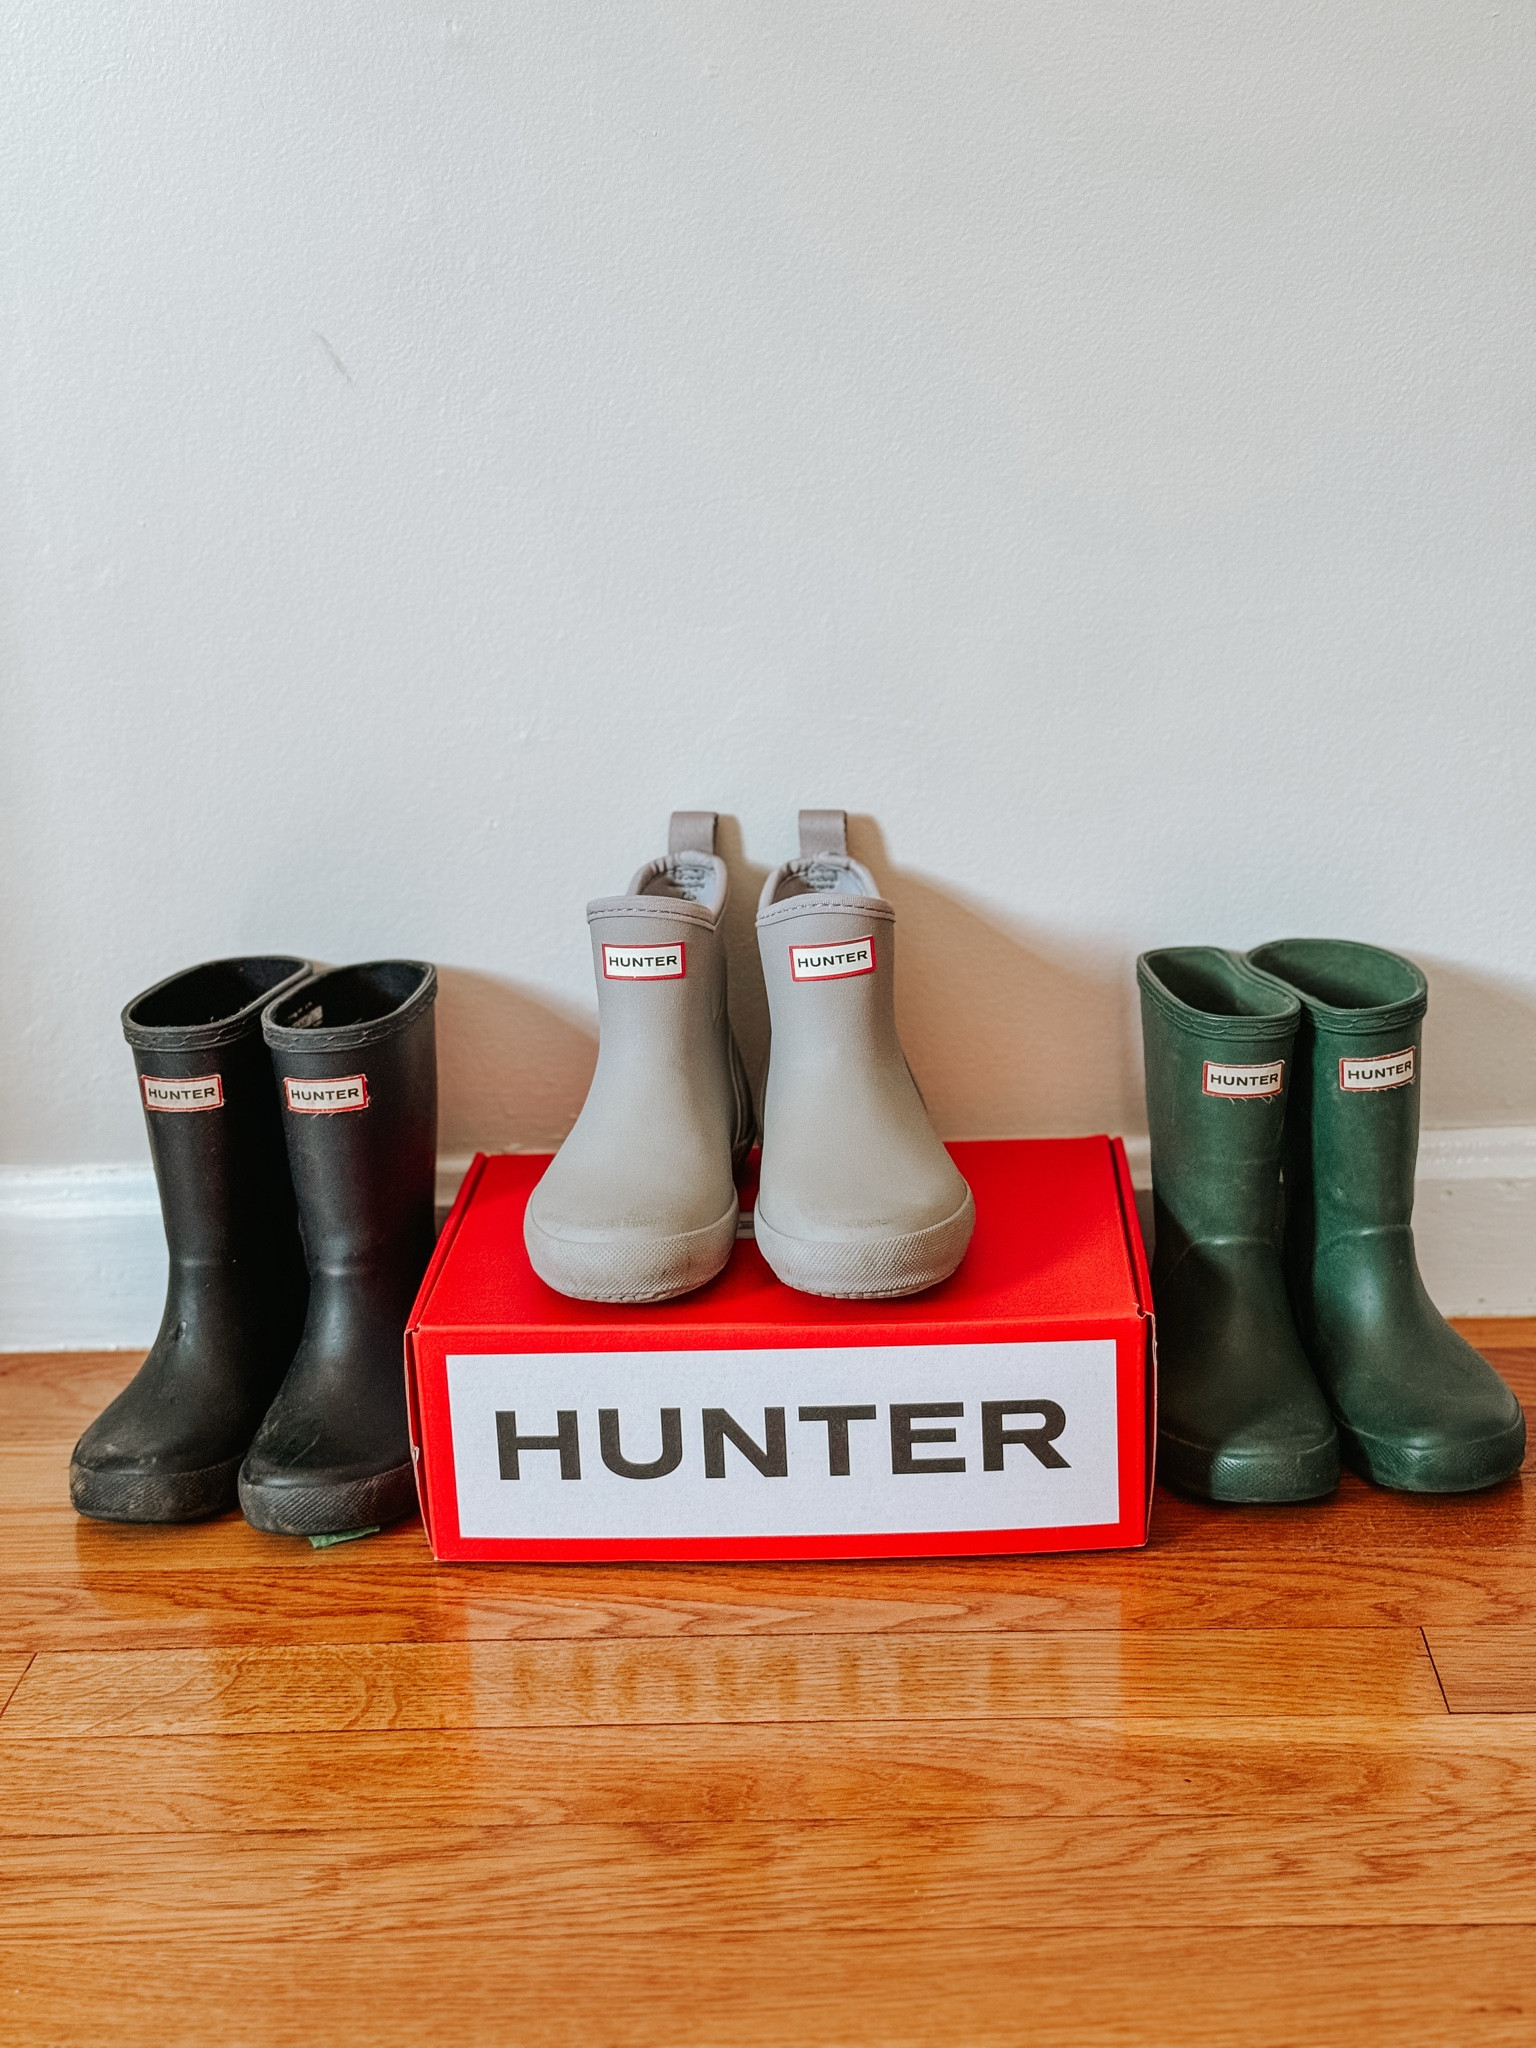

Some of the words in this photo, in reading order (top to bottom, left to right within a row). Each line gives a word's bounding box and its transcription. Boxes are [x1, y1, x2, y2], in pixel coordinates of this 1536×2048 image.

[609, 955, 677, 967] HUNTER
[797, 950, 868, 968] HUNTER
[1348, 1060, 1412, 1080] HUNTER
[1210, 1073, 1279, 1086] HUNTER
[148, 1087, 216, 1100] HUNTER
[291, 1088, 360, 1101] HUNTER
[495, 1398, 1072, 1481] HUNTER
